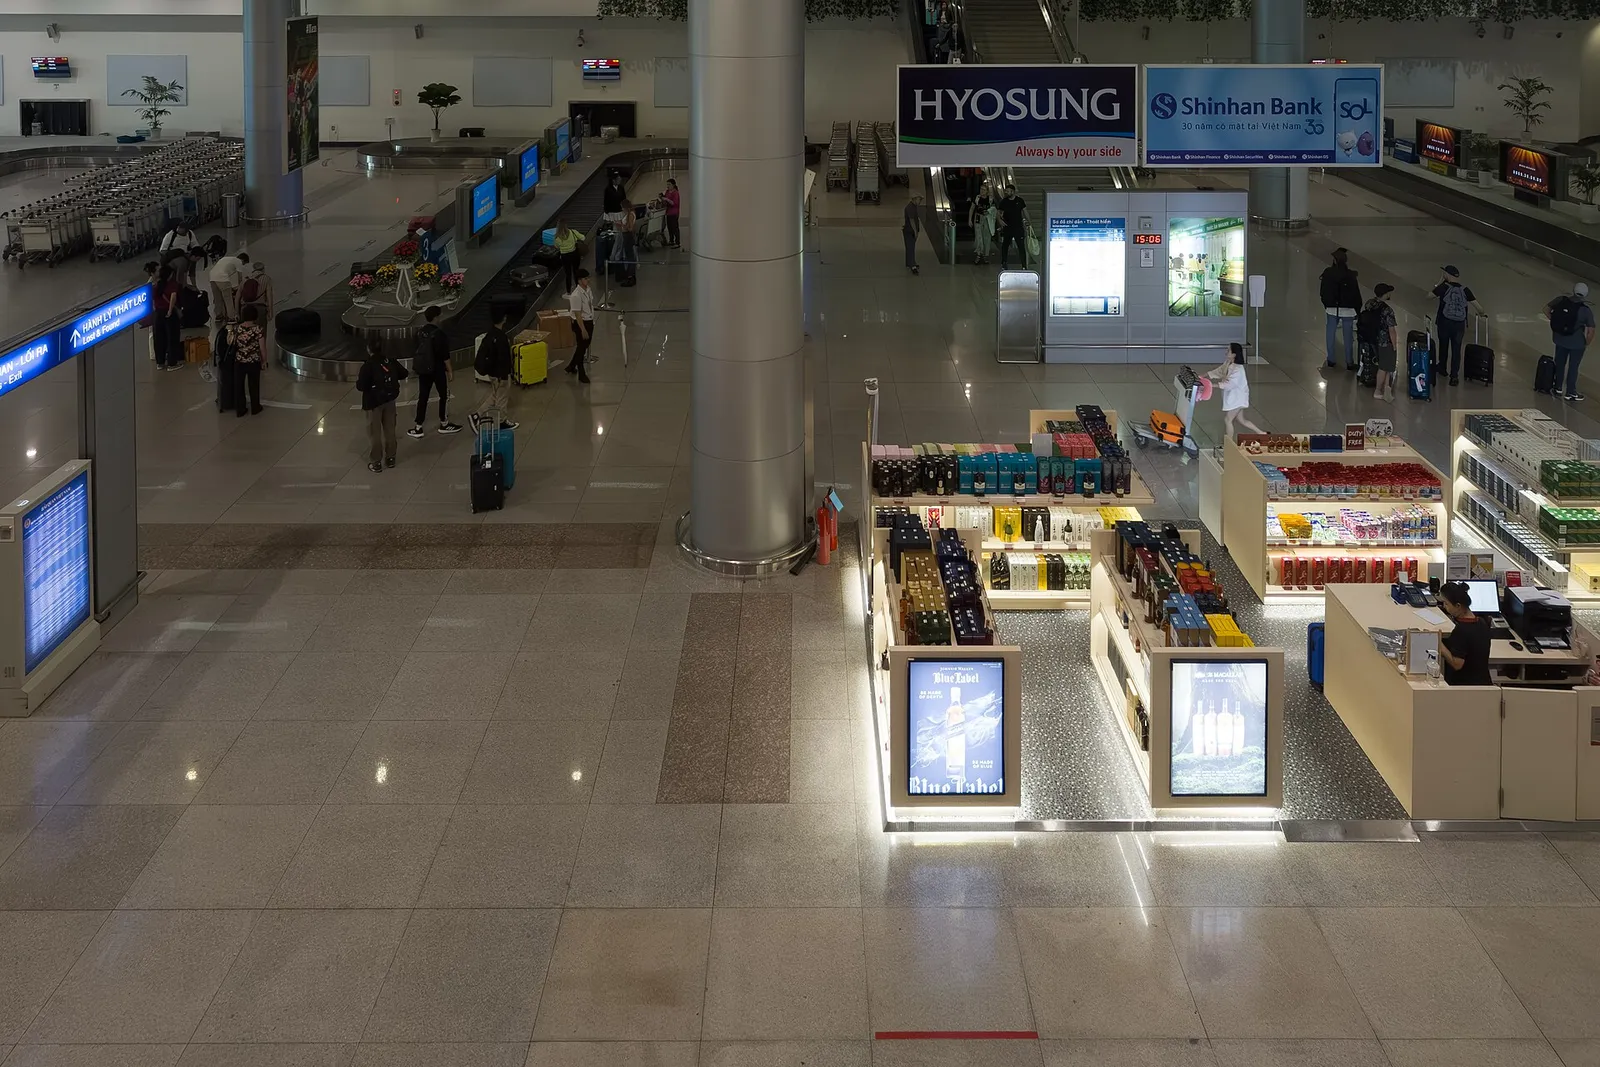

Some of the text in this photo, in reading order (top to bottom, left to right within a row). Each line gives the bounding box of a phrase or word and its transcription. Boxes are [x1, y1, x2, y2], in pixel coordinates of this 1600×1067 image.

[914, 88, 1120, 121] HYOSUNG
[1181, 97, 1322, 116] Shinhan Bank
[1195, 122, 1213, 130] năm
[1216, 121, 1226, 130] có
[1228, 121, 1246, 132] mặt
[1262, 122, 1280, 132] Việt
[1015, 146, 1122, 160] Always by your side
[1136, 235, 1161, 243] 15:06
[422, 237, 430, 261] 3
[82, 292, 147, 333] HÀNH LÝ THẤT LẠC
[82, 318, 120, 346] Lost & Found
[20, 346, 34, 365] LỐI
[36, 344, 48, 358] RA
[9, 370, 23, 384] Exit
[934, 672, 979, 684] Blue Label
